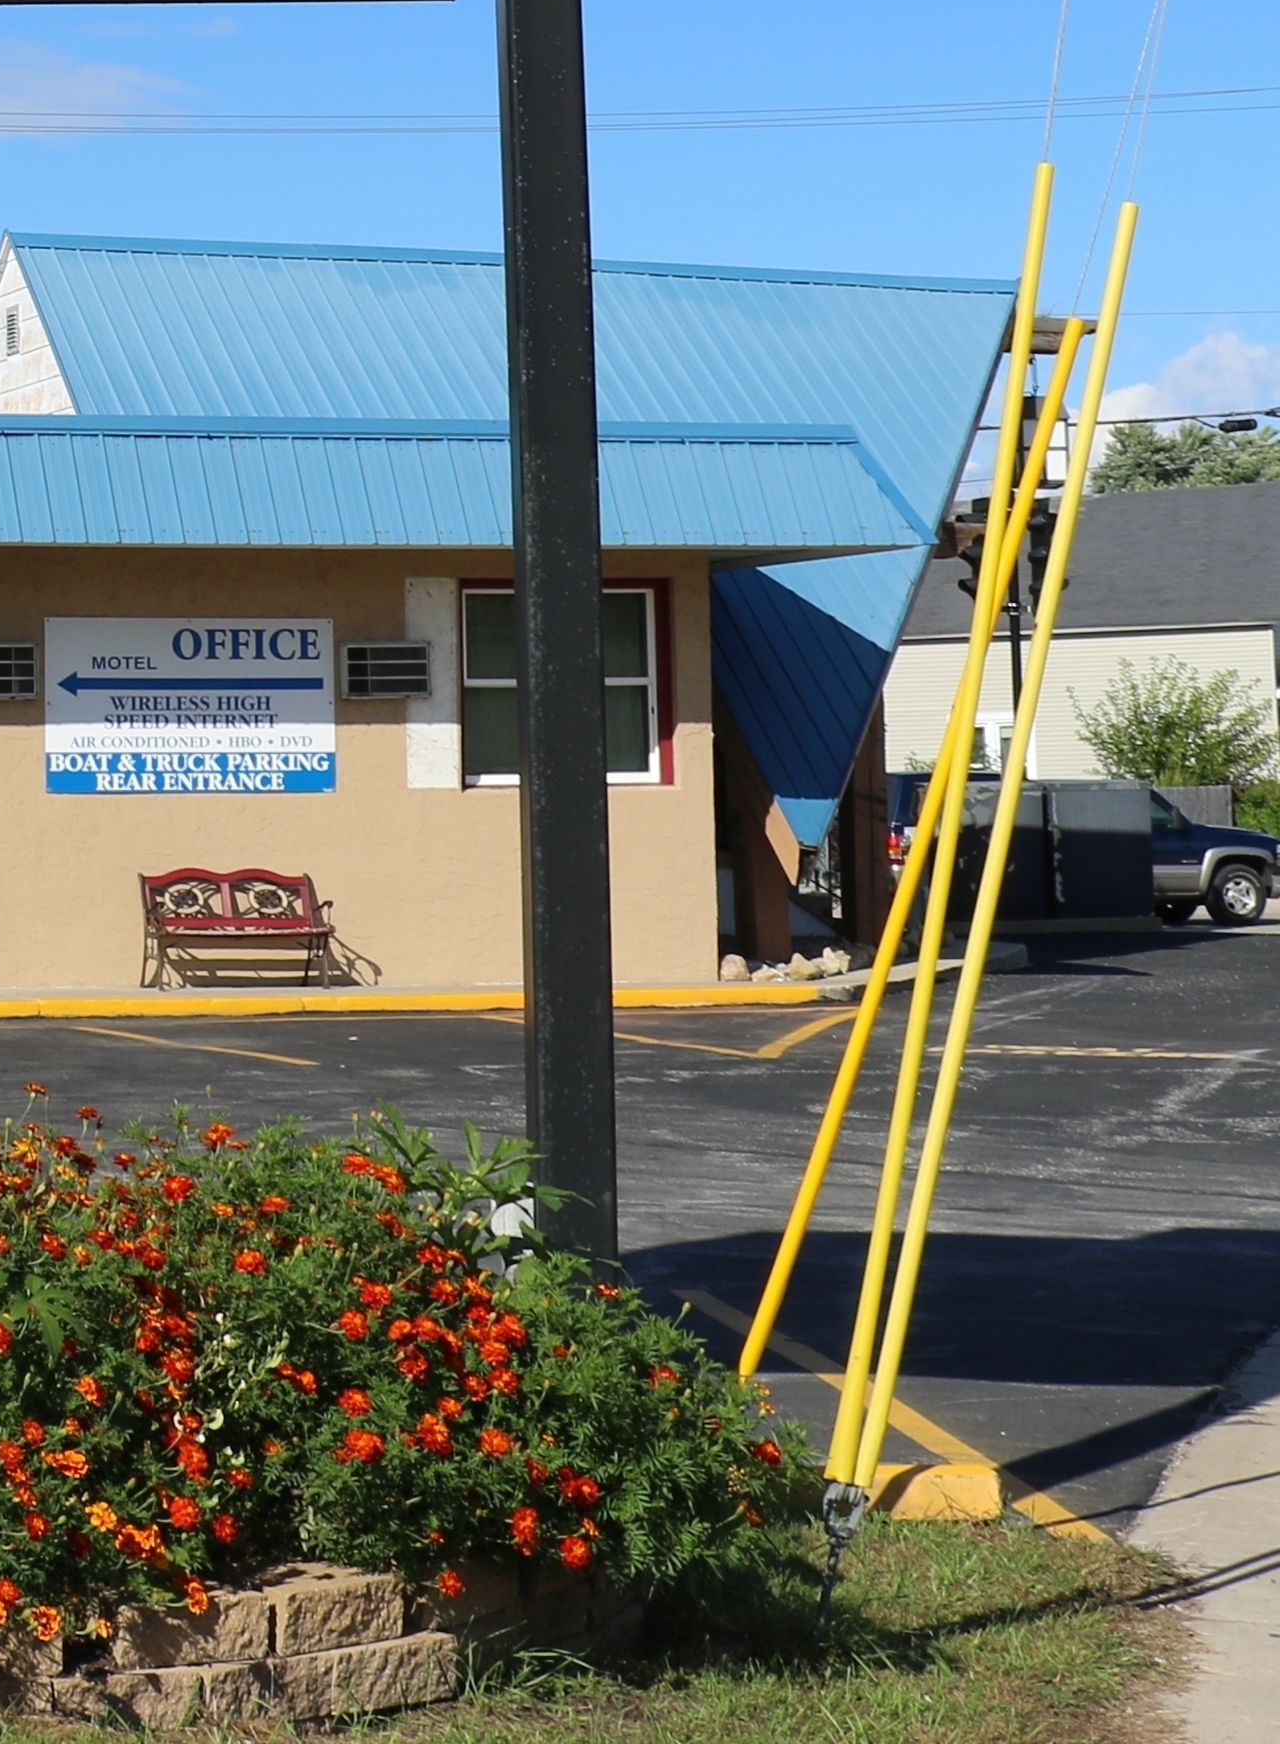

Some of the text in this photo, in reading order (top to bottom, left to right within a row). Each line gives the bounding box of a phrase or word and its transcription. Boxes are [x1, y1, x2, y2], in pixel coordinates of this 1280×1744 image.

[172, 627, 321, 661] OFFICE
[91, 656, 158, 670] MOTEL
[109, 696, 272, 711] WIRELESS HIGH
[104, 713, 279, 729] SPEED INTERNET
[70, 736, 313, 748] AIR CONDITIONED HBO DVD
[49, 753, 330, 772] BOAT & TRUCK PARKING
[96, 772, 285, 791] REAR ENTRANCE
